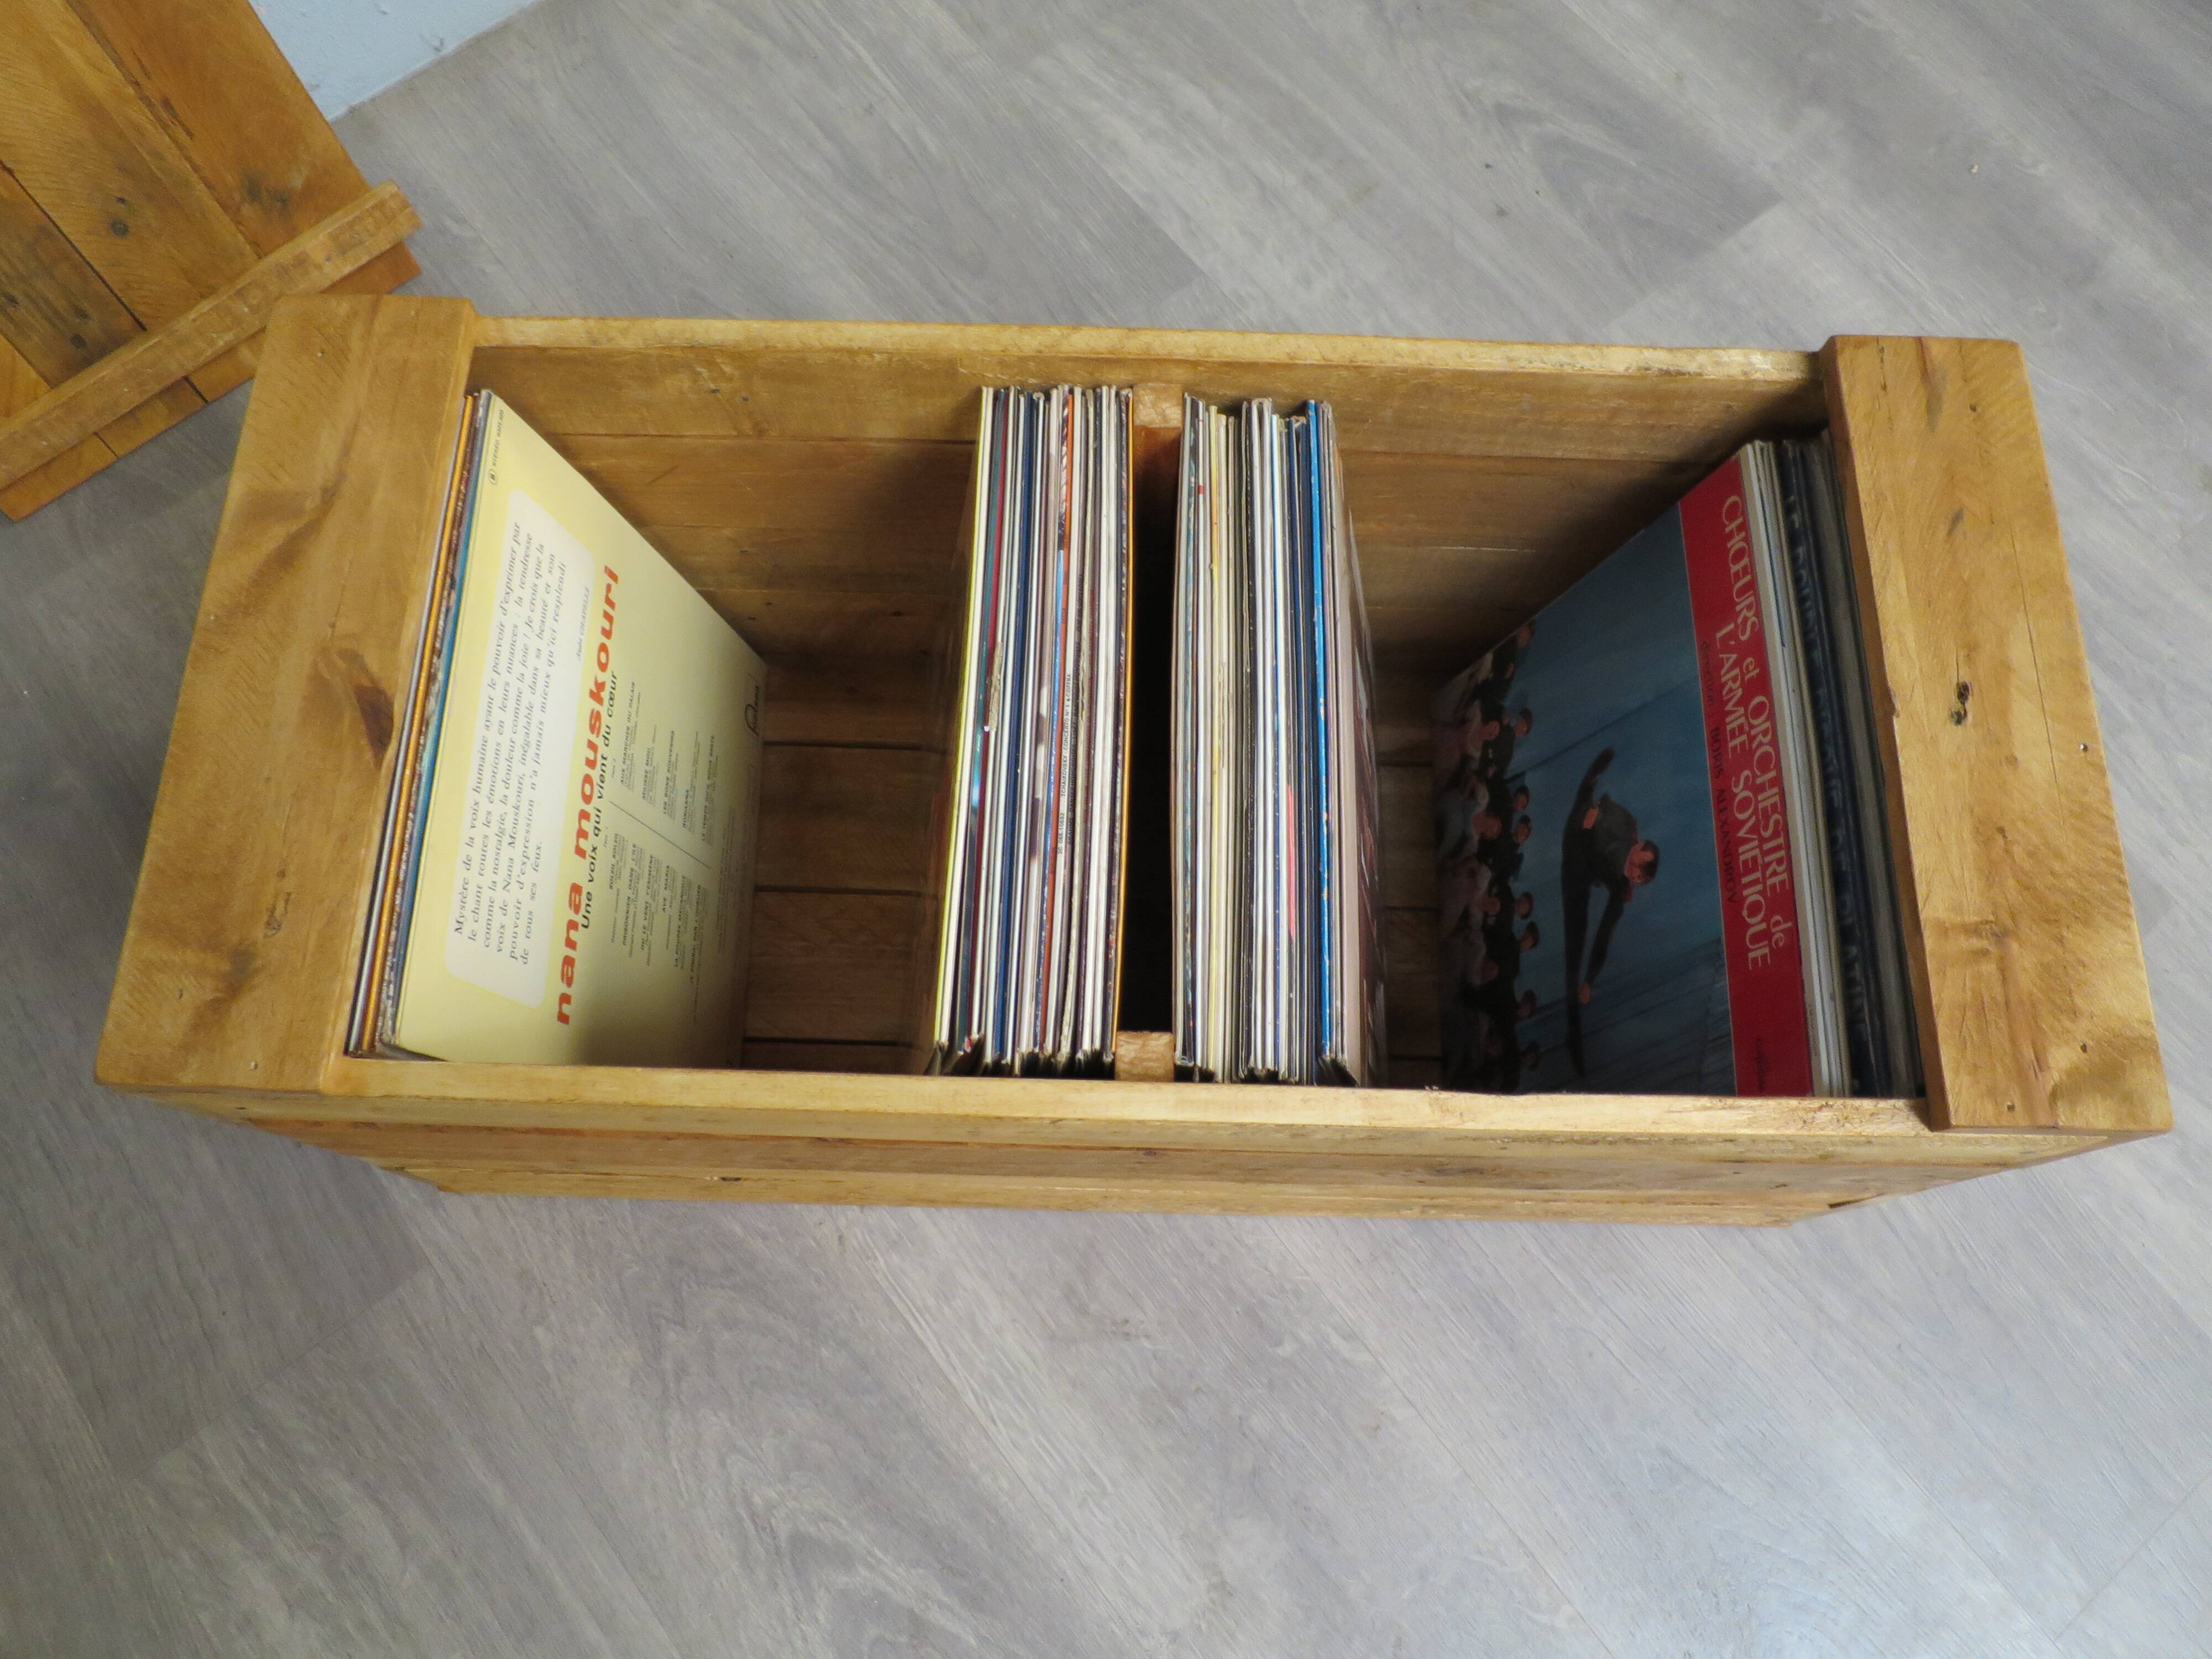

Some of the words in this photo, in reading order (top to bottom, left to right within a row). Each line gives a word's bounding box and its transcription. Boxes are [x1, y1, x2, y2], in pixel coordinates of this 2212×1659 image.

[513, 522, 521, 545] par
[535, 544, 544, 554] la
[519, 533, 533, 589] tendresse
[1723, 494, 1758, 641] CHŒURS
[499, 547, 517, 615] d'exprimer
[530, 583, 538, 613] crois
[545, 582, 551, 594] et
[553, 562, 566, 622] resplendi
[514, 596, 524, 607] la
[535, 599, 548, 640] beauté
[525, 616, 533, 629] Je
[493, 621, 505, 675] pouvoir
[507, 624, 518, 674] nuances
[519, 643, 529, 669] joie
[535, 648, 542, 660] sa
[547, 629, 557, 667] qu'ici
[487, 679, 497, 690] le
[517, 672, 525, 683] la
[528, 666, 539, 695] dans
[1716, 620, 1748, 757] L'ARMÉE
[1743, 658, 1759, 682] et
[498, 681, 510, 712] leurs
[512, 687, 523, 734] comme
[541, 673, 551, 713] mieux
[607, 671, 617, 718] cœur
[484, 696, 494, 731] ayant
[498, 720, 505, 735] en
[627, 711, 632, 723] DU
[519, 701, 534, 765] inégalable
[533, 721, 544, 765] jamais
[602, 724, 611, 747] du
[472, 736, 488, 794] humaine
[502, 738, 515, 789] douleur
[667, 731, 675, 774] SOUVENIRS
[1712, 725, 1726, 780] BORIS
[487, 742, 501, 804] émotions
[530, 770, 538, 790] n'a
[597, 754, 608, 799] vient
[1060, 755, 1068, 797] TCHAIKOVSKY
[499, 794, 508, 805] la
[508, 774, 525, 848] Mouskouri,
[557, 883, 583, 1025] nana
[574, 565, 619, 860] mouskouri
[1748, 697, 1787, 894] ORCHESTRE
[471, 801, 479, 828] voix
[482, 810, 492, 828] les
[593, 807, 602, 837] qui
[465, 836, 475, 847] la
[478, 834, 489, 877] toutes
[493, 812, 507, 875] nostalgie,
[516, 800, 534, 890] d'expression
[1717, 787, 1738, 905] ALEXANDROV
[462, 854, 472, 871] de
[502, 858, 514, 892] Nana
[588, 846, 598, 883] voix
[1731, 769, 1769, 971] SOVIÉTIQUE
[471, 885, 483, 922] chant
[488, 880, 497, 891] la
[520, 948, 529, 964] de
[531, 843, 541, 872] feux.
[455, 878, 469, 934] Mystère
[484, 897, 494, 947] comme
[499, 900, 508, 916] de
[581, 891, 592, 928] Une
[622, 896, 631, 946] PRISONNIER
[468, 929, 477, 941] le
[497, 924, 505, 952] voix
[510, 899, 521, 960] pouvoir
[643, 925, 647, 934] LE
[1770, 915, 1792, 948] de
